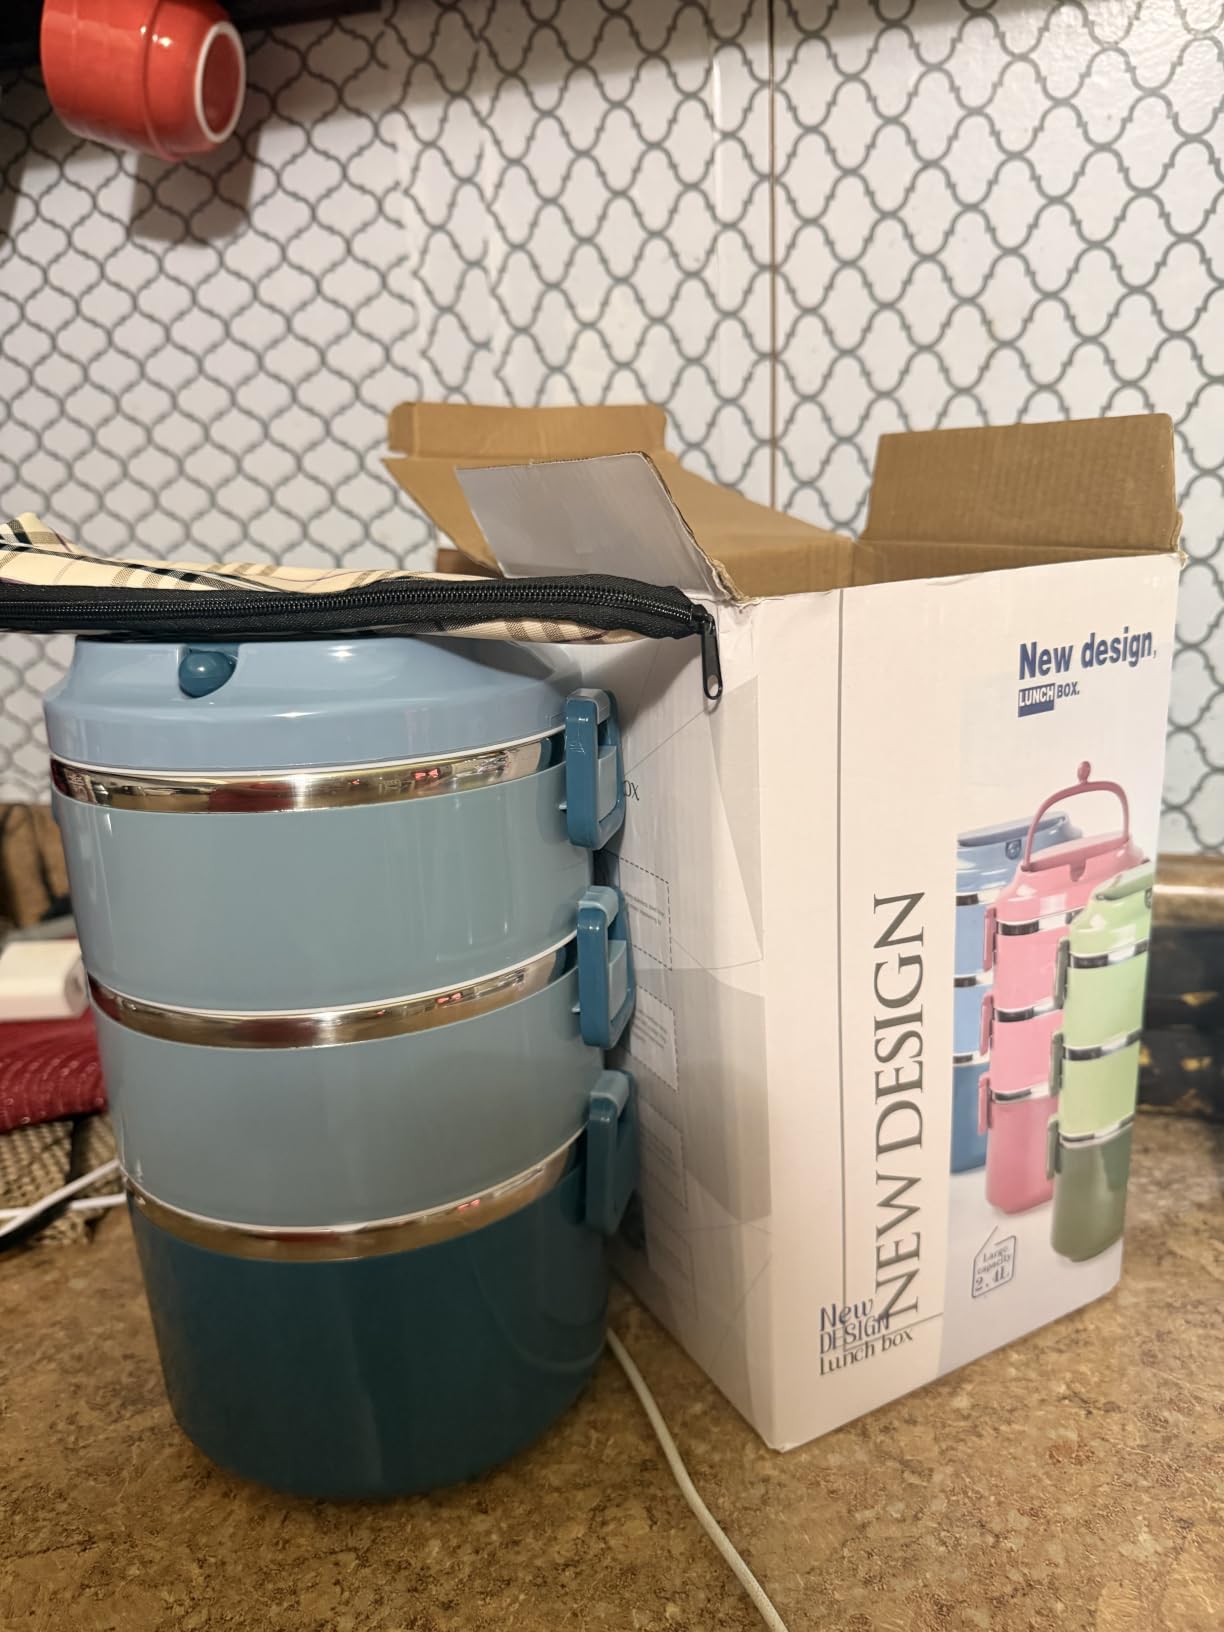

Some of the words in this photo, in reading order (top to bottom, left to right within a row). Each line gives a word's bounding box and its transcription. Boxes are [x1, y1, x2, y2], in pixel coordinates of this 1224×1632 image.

[1018, 641, 1074, 681] New
[1018, 684, 1055, 708] LUNCH
[873, 892, 925, 1162] DESIGN
[874, 1170, 922, 1321] NEW
[977, 1253, 1011, 1275] capacity
[820, 1298, 873, 1332] New
[820, 1314, 889, 1354] DESIGN
[820, 1340, 875, 1376] Lunch
[881, 1328, 913, 1352] box
